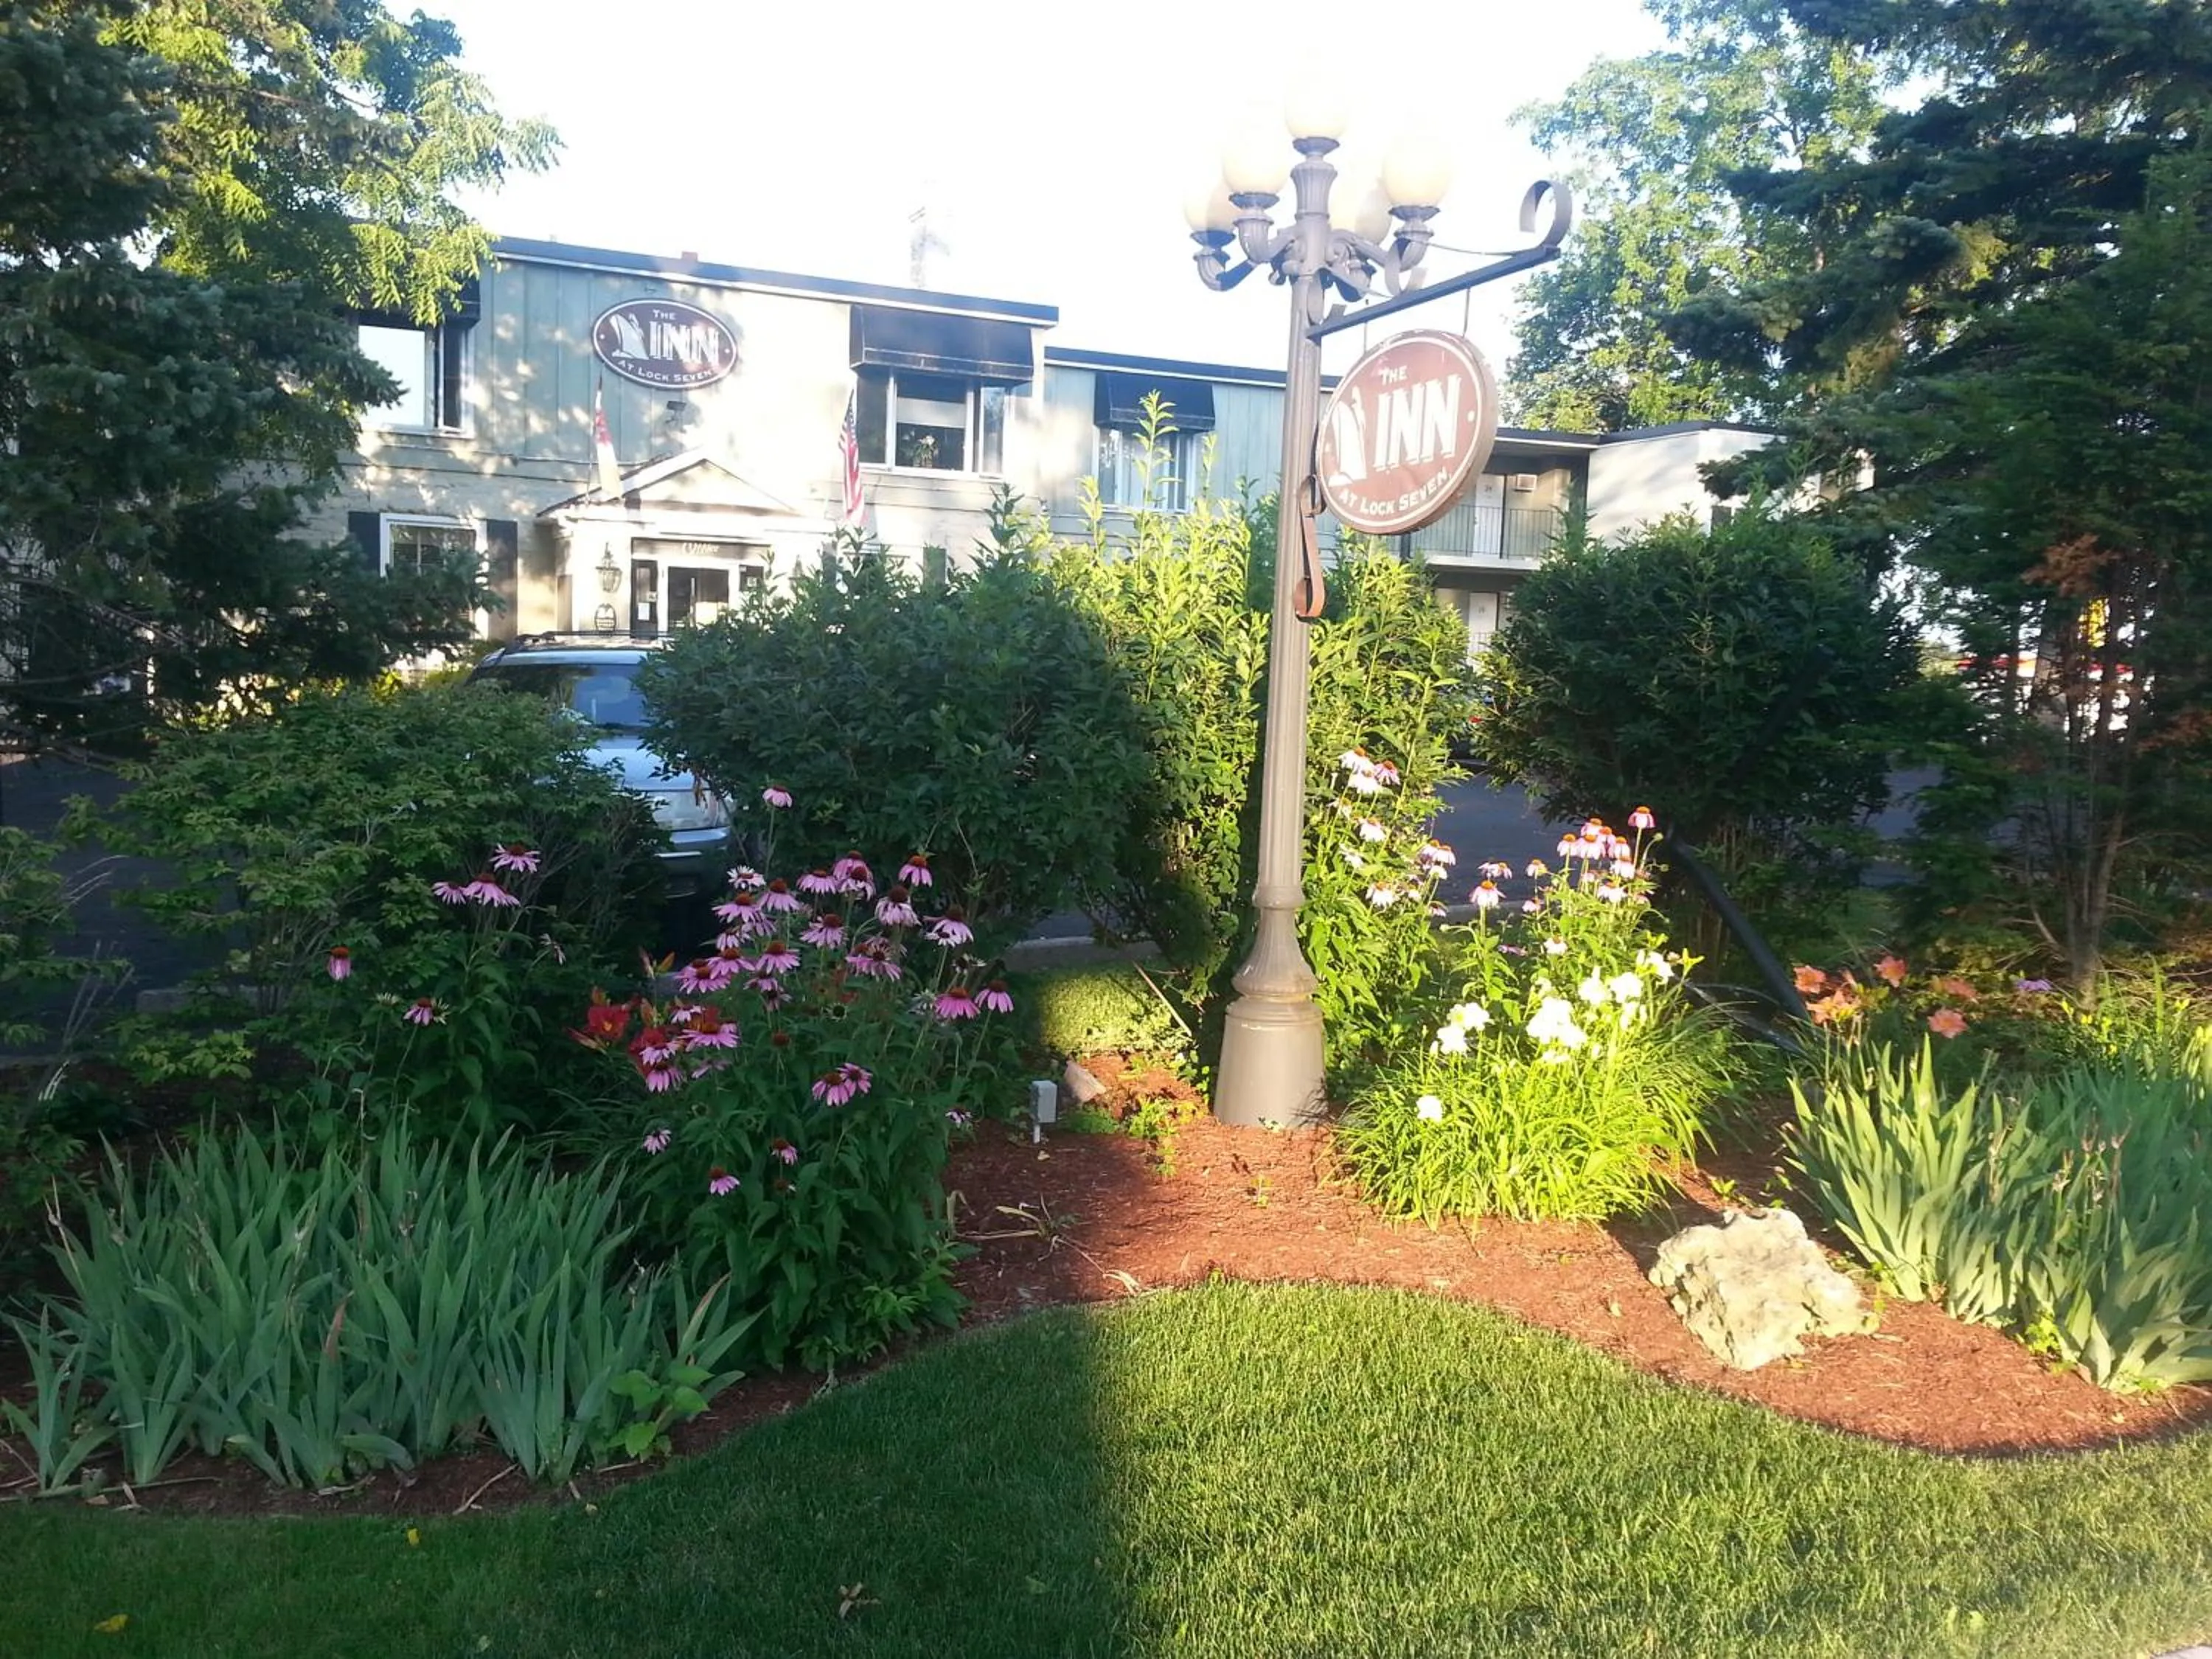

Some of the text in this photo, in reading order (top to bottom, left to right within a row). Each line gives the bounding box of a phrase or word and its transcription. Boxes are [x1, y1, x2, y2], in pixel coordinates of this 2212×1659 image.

[653, 309, 676, 321] THE
[649, 321, 719, 367] INN
[618, 360, 712, 383] AT LOCK SEVEN
[1380, 365, 1408, 386] THE
[1374, 374, 1462, 473] INN
[1339, 467, 1450, 515] AT LOCK SEVEN
